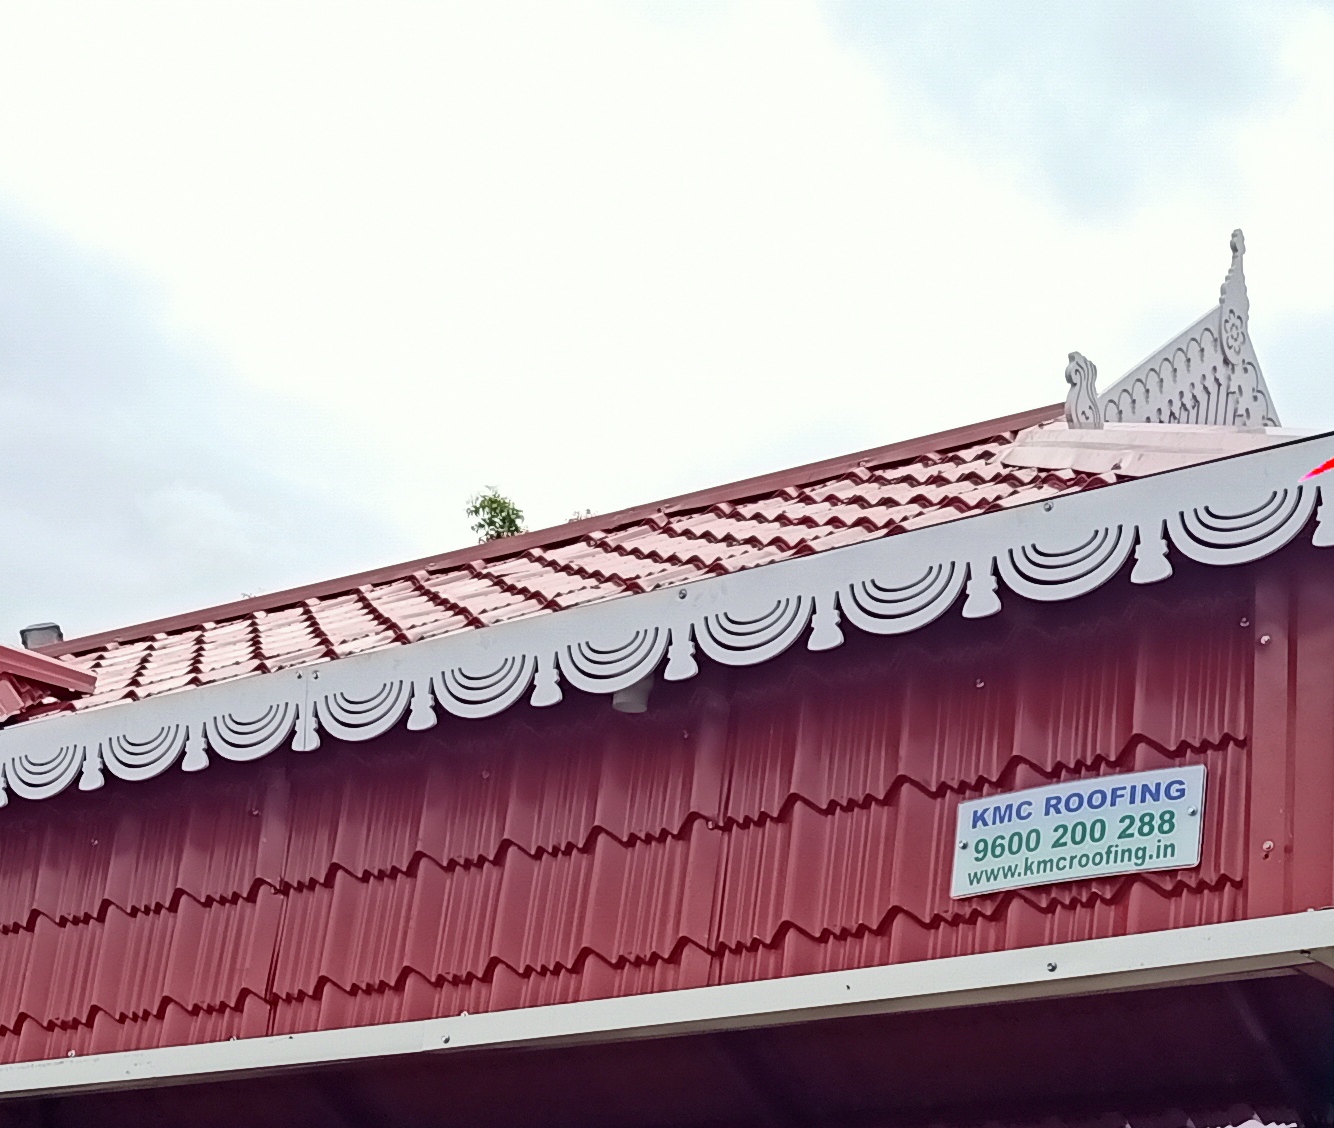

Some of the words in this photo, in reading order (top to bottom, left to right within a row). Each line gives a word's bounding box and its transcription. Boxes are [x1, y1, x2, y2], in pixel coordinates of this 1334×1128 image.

[971, 800, 1033, 829] KMC
[1043, 779, 1187, 817] ROOFING
[973, 828, 1041, 862] 9600
[1051, 817, 1106, 849] 200
[1117, 809, 1176, 840] 288
[967, 838, 1176, 886] www.kmcroofing.in
